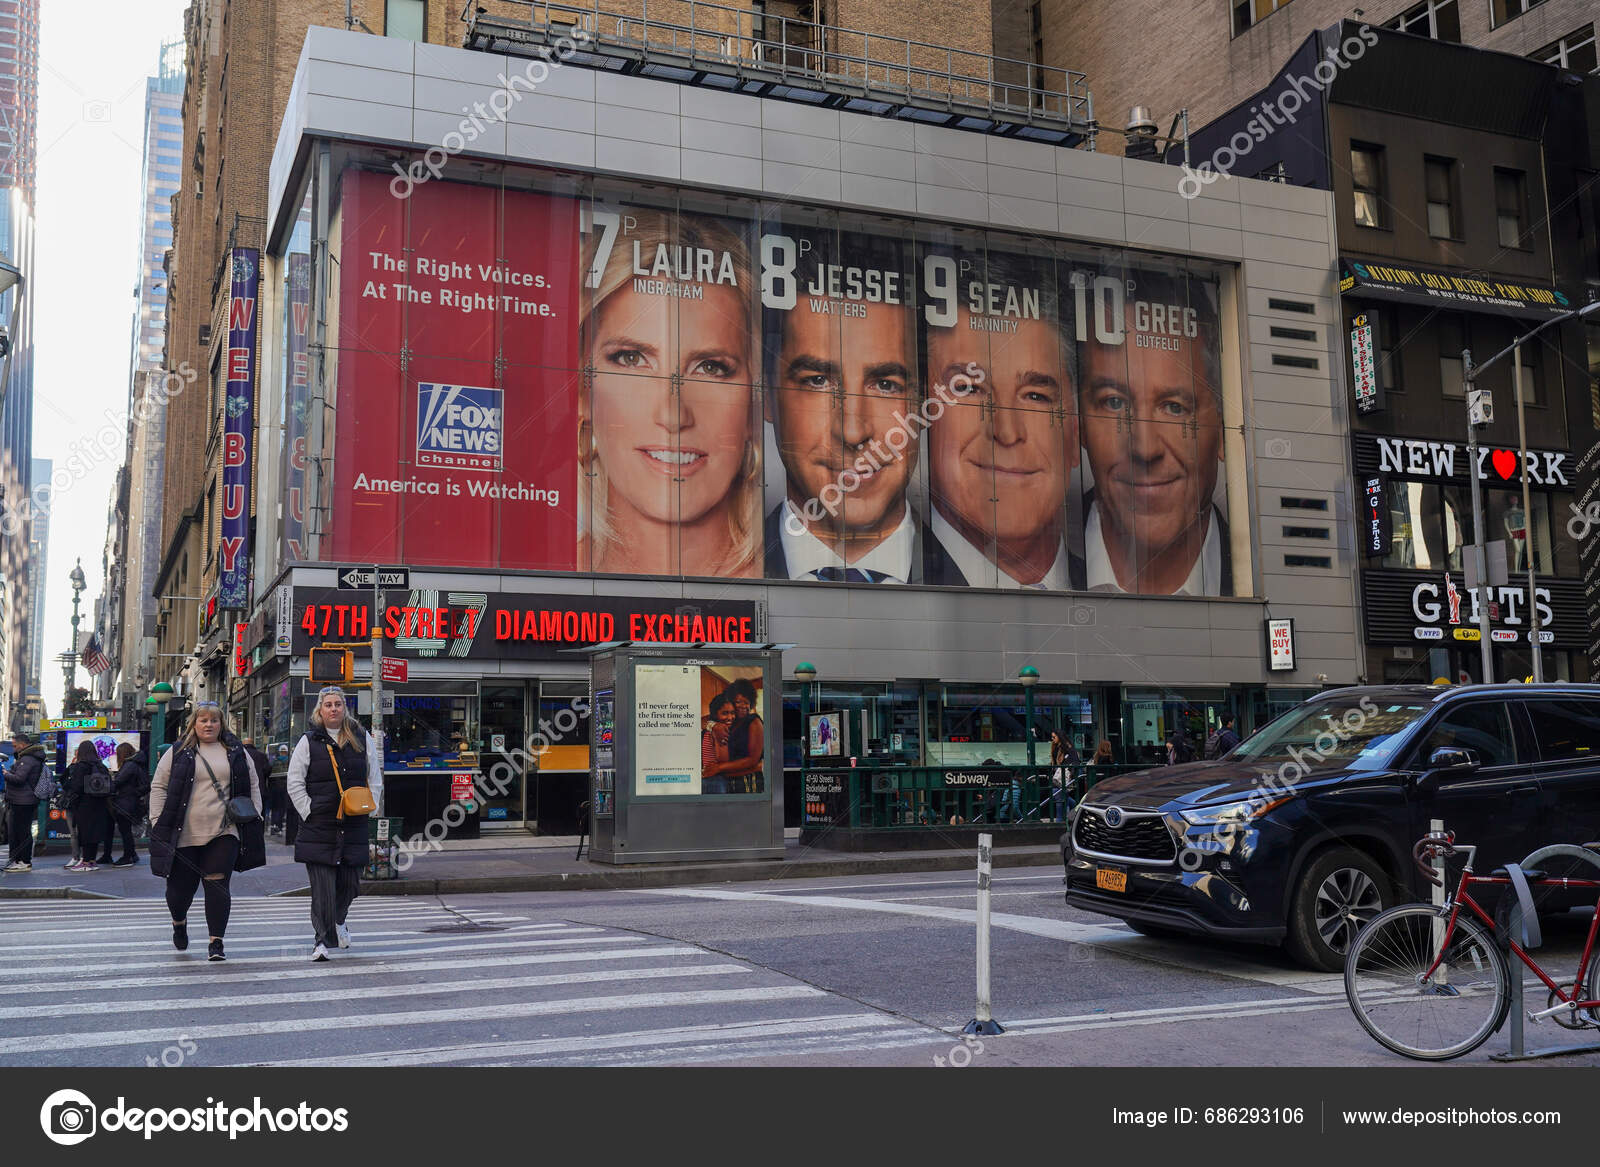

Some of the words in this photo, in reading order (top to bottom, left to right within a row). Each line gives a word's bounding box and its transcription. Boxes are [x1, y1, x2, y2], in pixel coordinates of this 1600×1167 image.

[369, 252, 408, 272] The
[416, 257, 472, 282] Right
[478, 264, 551, 288] Voices.
[633, 240, 737, 287] LAURA
[634, 278, 703, 300] INGRAHAM
[808, 263, 899, 305] JESSE
[1365, 264, 1421, 287] MIDTOWN
[1421, 272, 1453, 291] GOLD
[1496, 283, 1530, 301] PAWN
[1528, 288, 1557, 304] SHOP
[1427, 289, 1441, 297] WE
[1441, 290, 1456, 299] BUY
[362, 281, 386, 299] At
[392, 283, 432, 304] The
[439, 288, 495, 313] Right
[502, 295, 556, 317] Time.
[810, 300, 867, 318] WATTERS
[968, 281, 1040, 320] SEAN
[969, 317, 1018, 334] HANNITY
[1135, 301, 1197, 338] GREG
[1136, 334, 1179, 351] GUTFELD
[447, 405, 501, 429] FOX
[431, 428, 500, 452] NEWS
[421, 454, 500, 469] channel
[1377, 438, 1456, 477] NEW
[1467, 446, 1568, 485] YRK
[353, 472, 440, 495] America
[446, 478, 460, 496] is
[467, 479, 560, 507] Watching
[1366, 485, 1381, 495] YRK
[222, 432, 247, 573] BUY
[348, 574, 368, 583] ONE
[379, 574, 400, 583] WAY
[1412, 572, 1553, 627] GFTS
[302, 604, 367, 636] 47TH
[385, 605, 480, 641] STREET
[496, 609, 614, 642] DIAMOND
[630, 614, 751, 643] EXCHANGE
[1274, 629, 1287, 637] WE
[1272, 639, 1289, 648] BUY
[669, 702, 689, 711] forget
[945, 772, 989, 786] Subway
